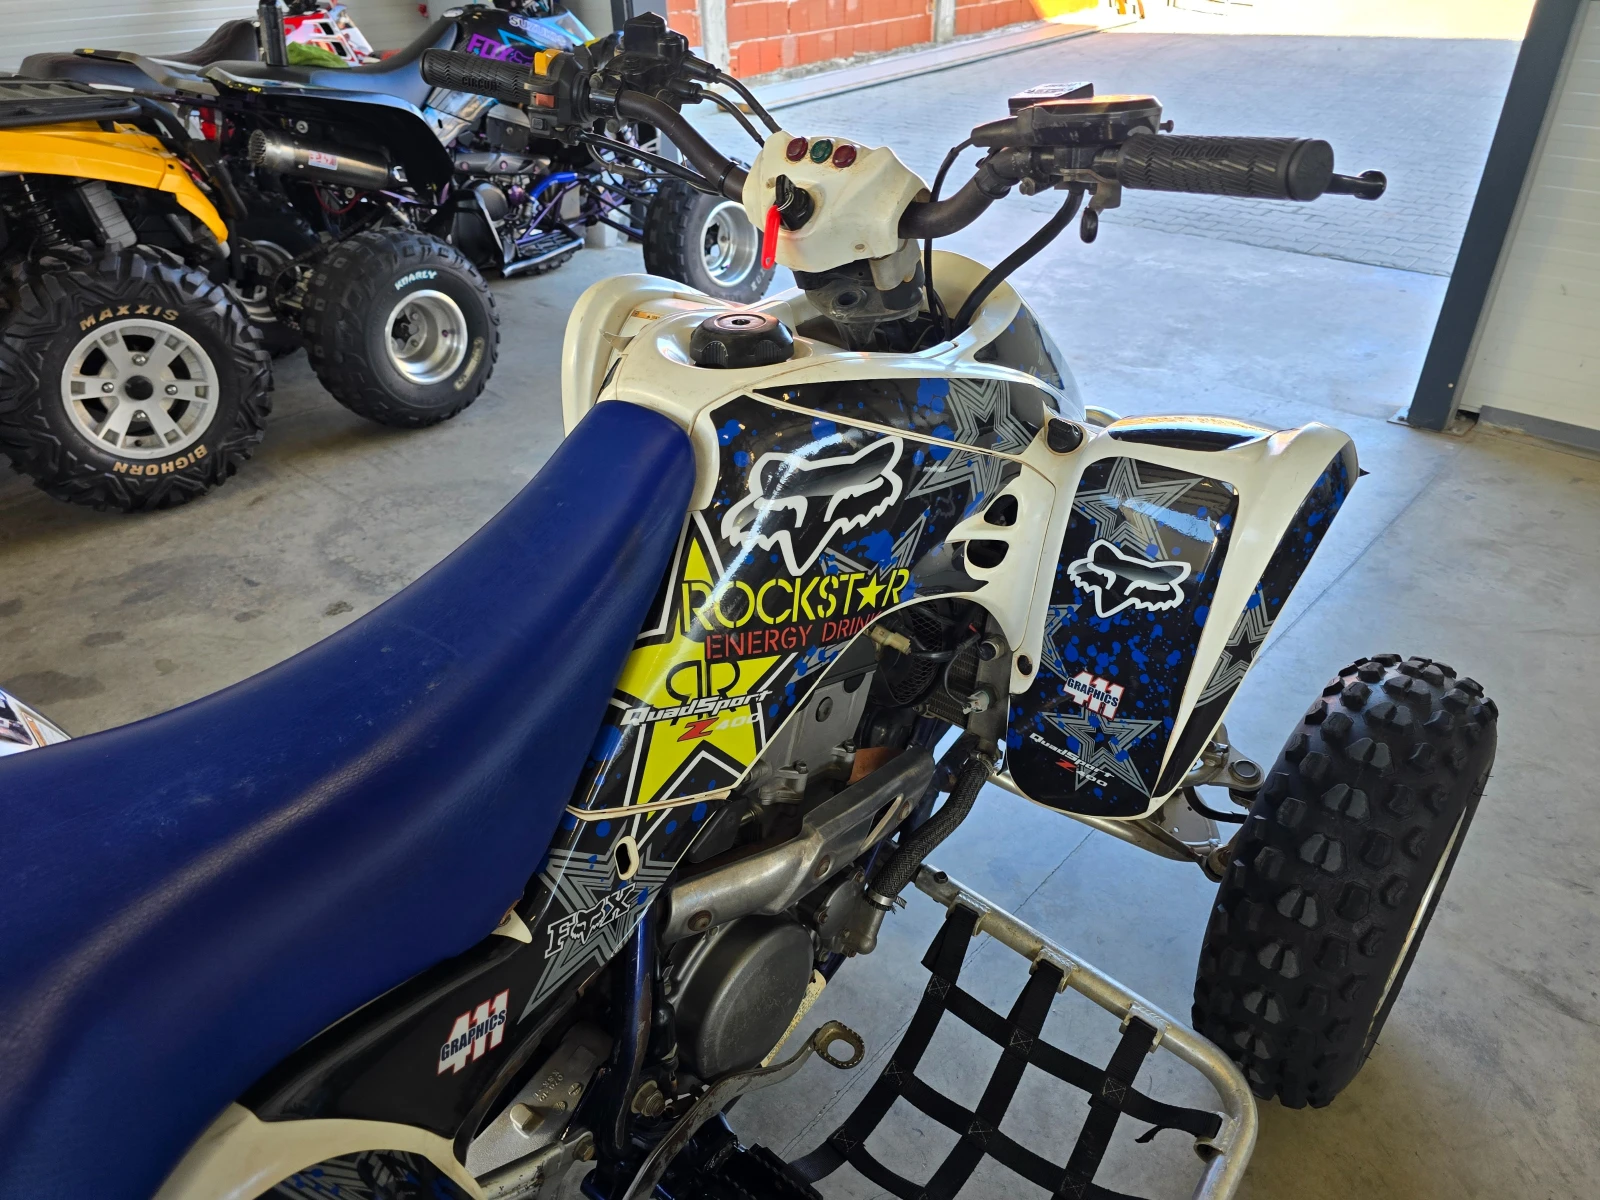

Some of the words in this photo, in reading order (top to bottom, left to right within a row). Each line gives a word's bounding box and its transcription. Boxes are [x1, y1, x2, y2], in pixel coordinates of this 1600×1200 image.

[79, 304, 180, 331] MAXXIS
[112, 444, 208, 476] BIGHORN
[704, 624, 813, 660] ENERGY
[619, 688, 774, 727] QuadSport
[1067, 678, 1119, 707] GRAPHICS
[436, 987, 510, 1076] 411
[440, 1009, 507, 1062] GRAPHICS
